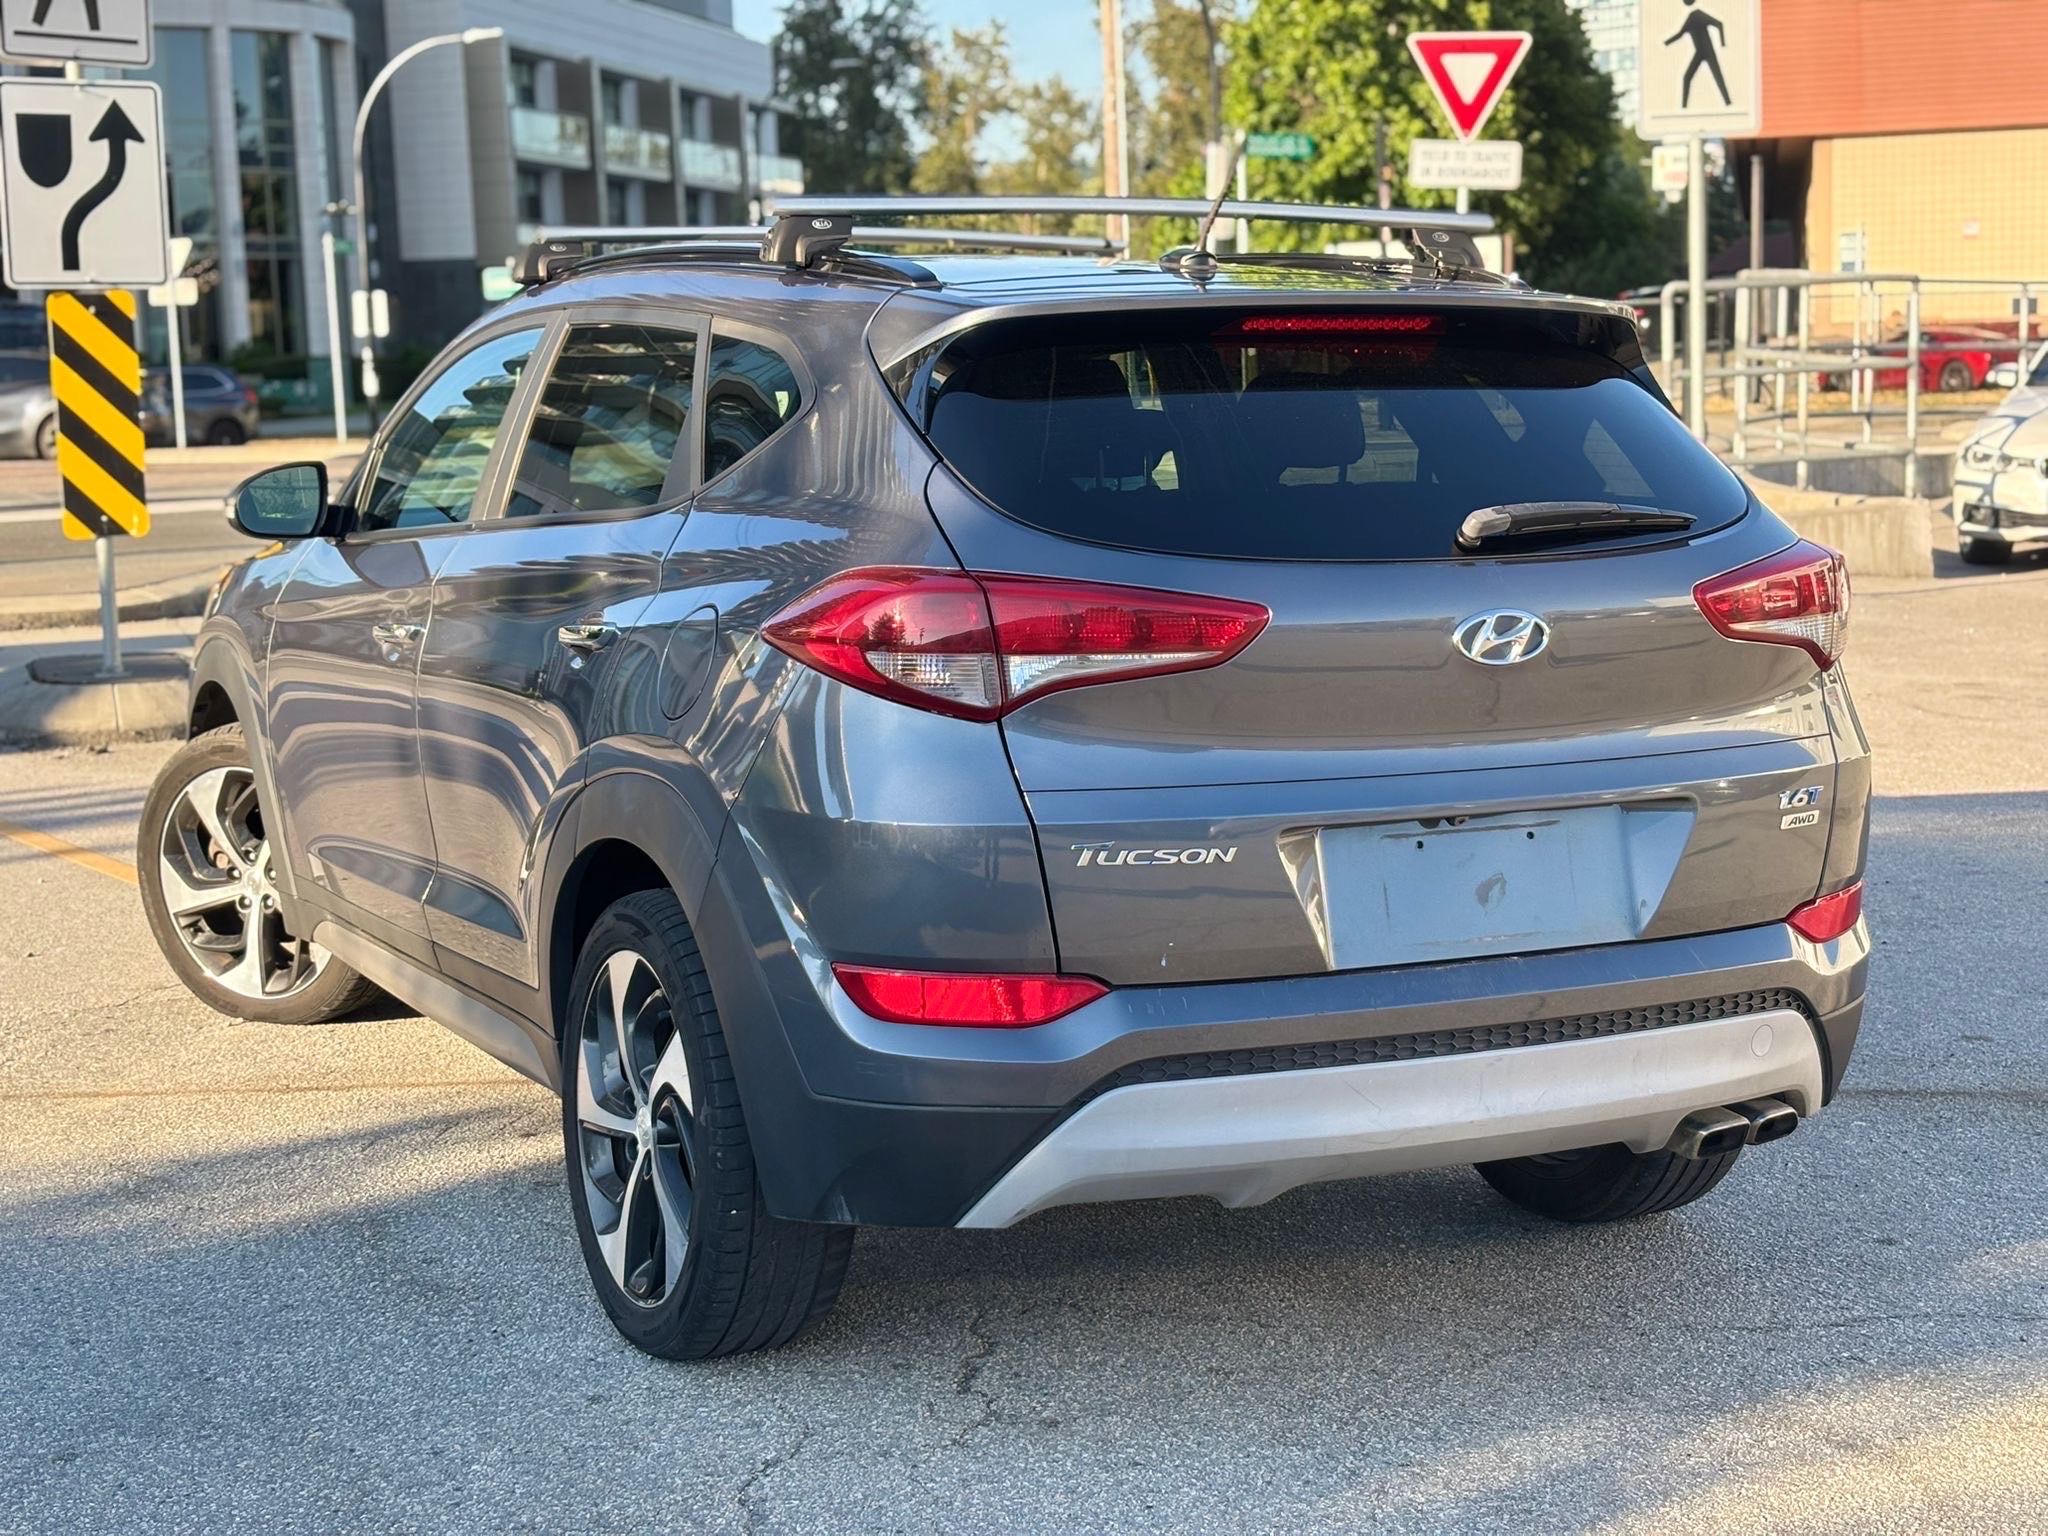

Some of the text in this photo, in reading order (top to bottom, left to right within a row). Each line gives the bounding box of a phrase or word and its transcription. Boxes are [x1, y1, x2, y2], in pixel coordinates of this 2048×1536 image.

[813, 219, 831, 228] KIA
[1787, 813, 1815, 827] AWD
[1071, 841, 1238, 867] TUCSON
